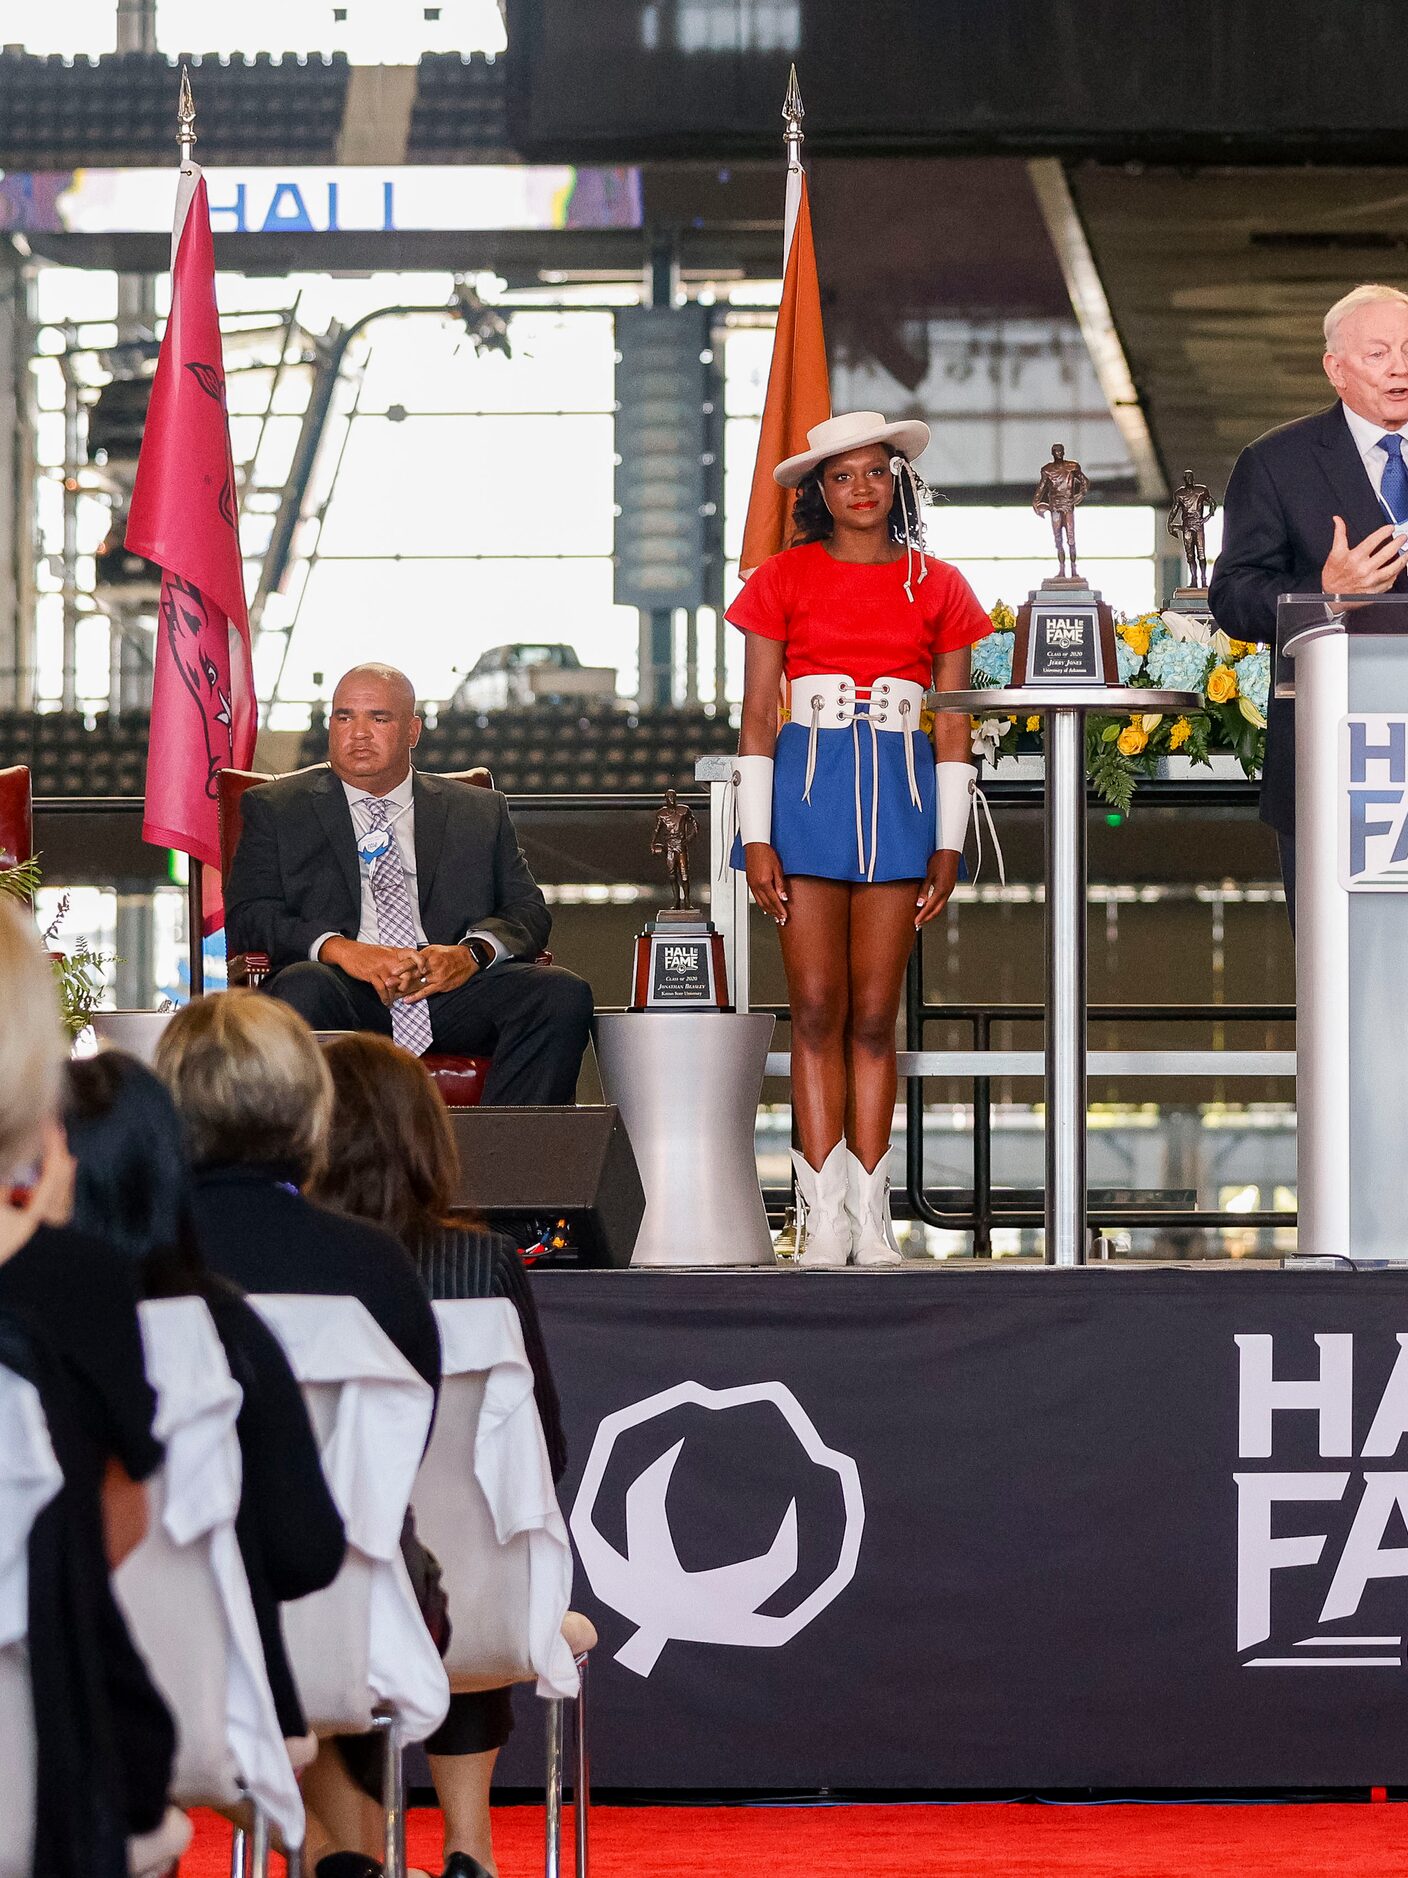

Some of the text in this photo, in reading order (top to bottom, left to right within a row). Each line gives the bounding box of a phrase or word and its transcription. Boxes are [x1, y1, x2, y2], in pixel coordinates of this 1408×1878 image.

[1046, 618, 1084, 629] HALL
[1046, 630, 1084, 644] FAME
[665, 947, 699, 956] HALL
[665, 957, 699, 970] FAME
